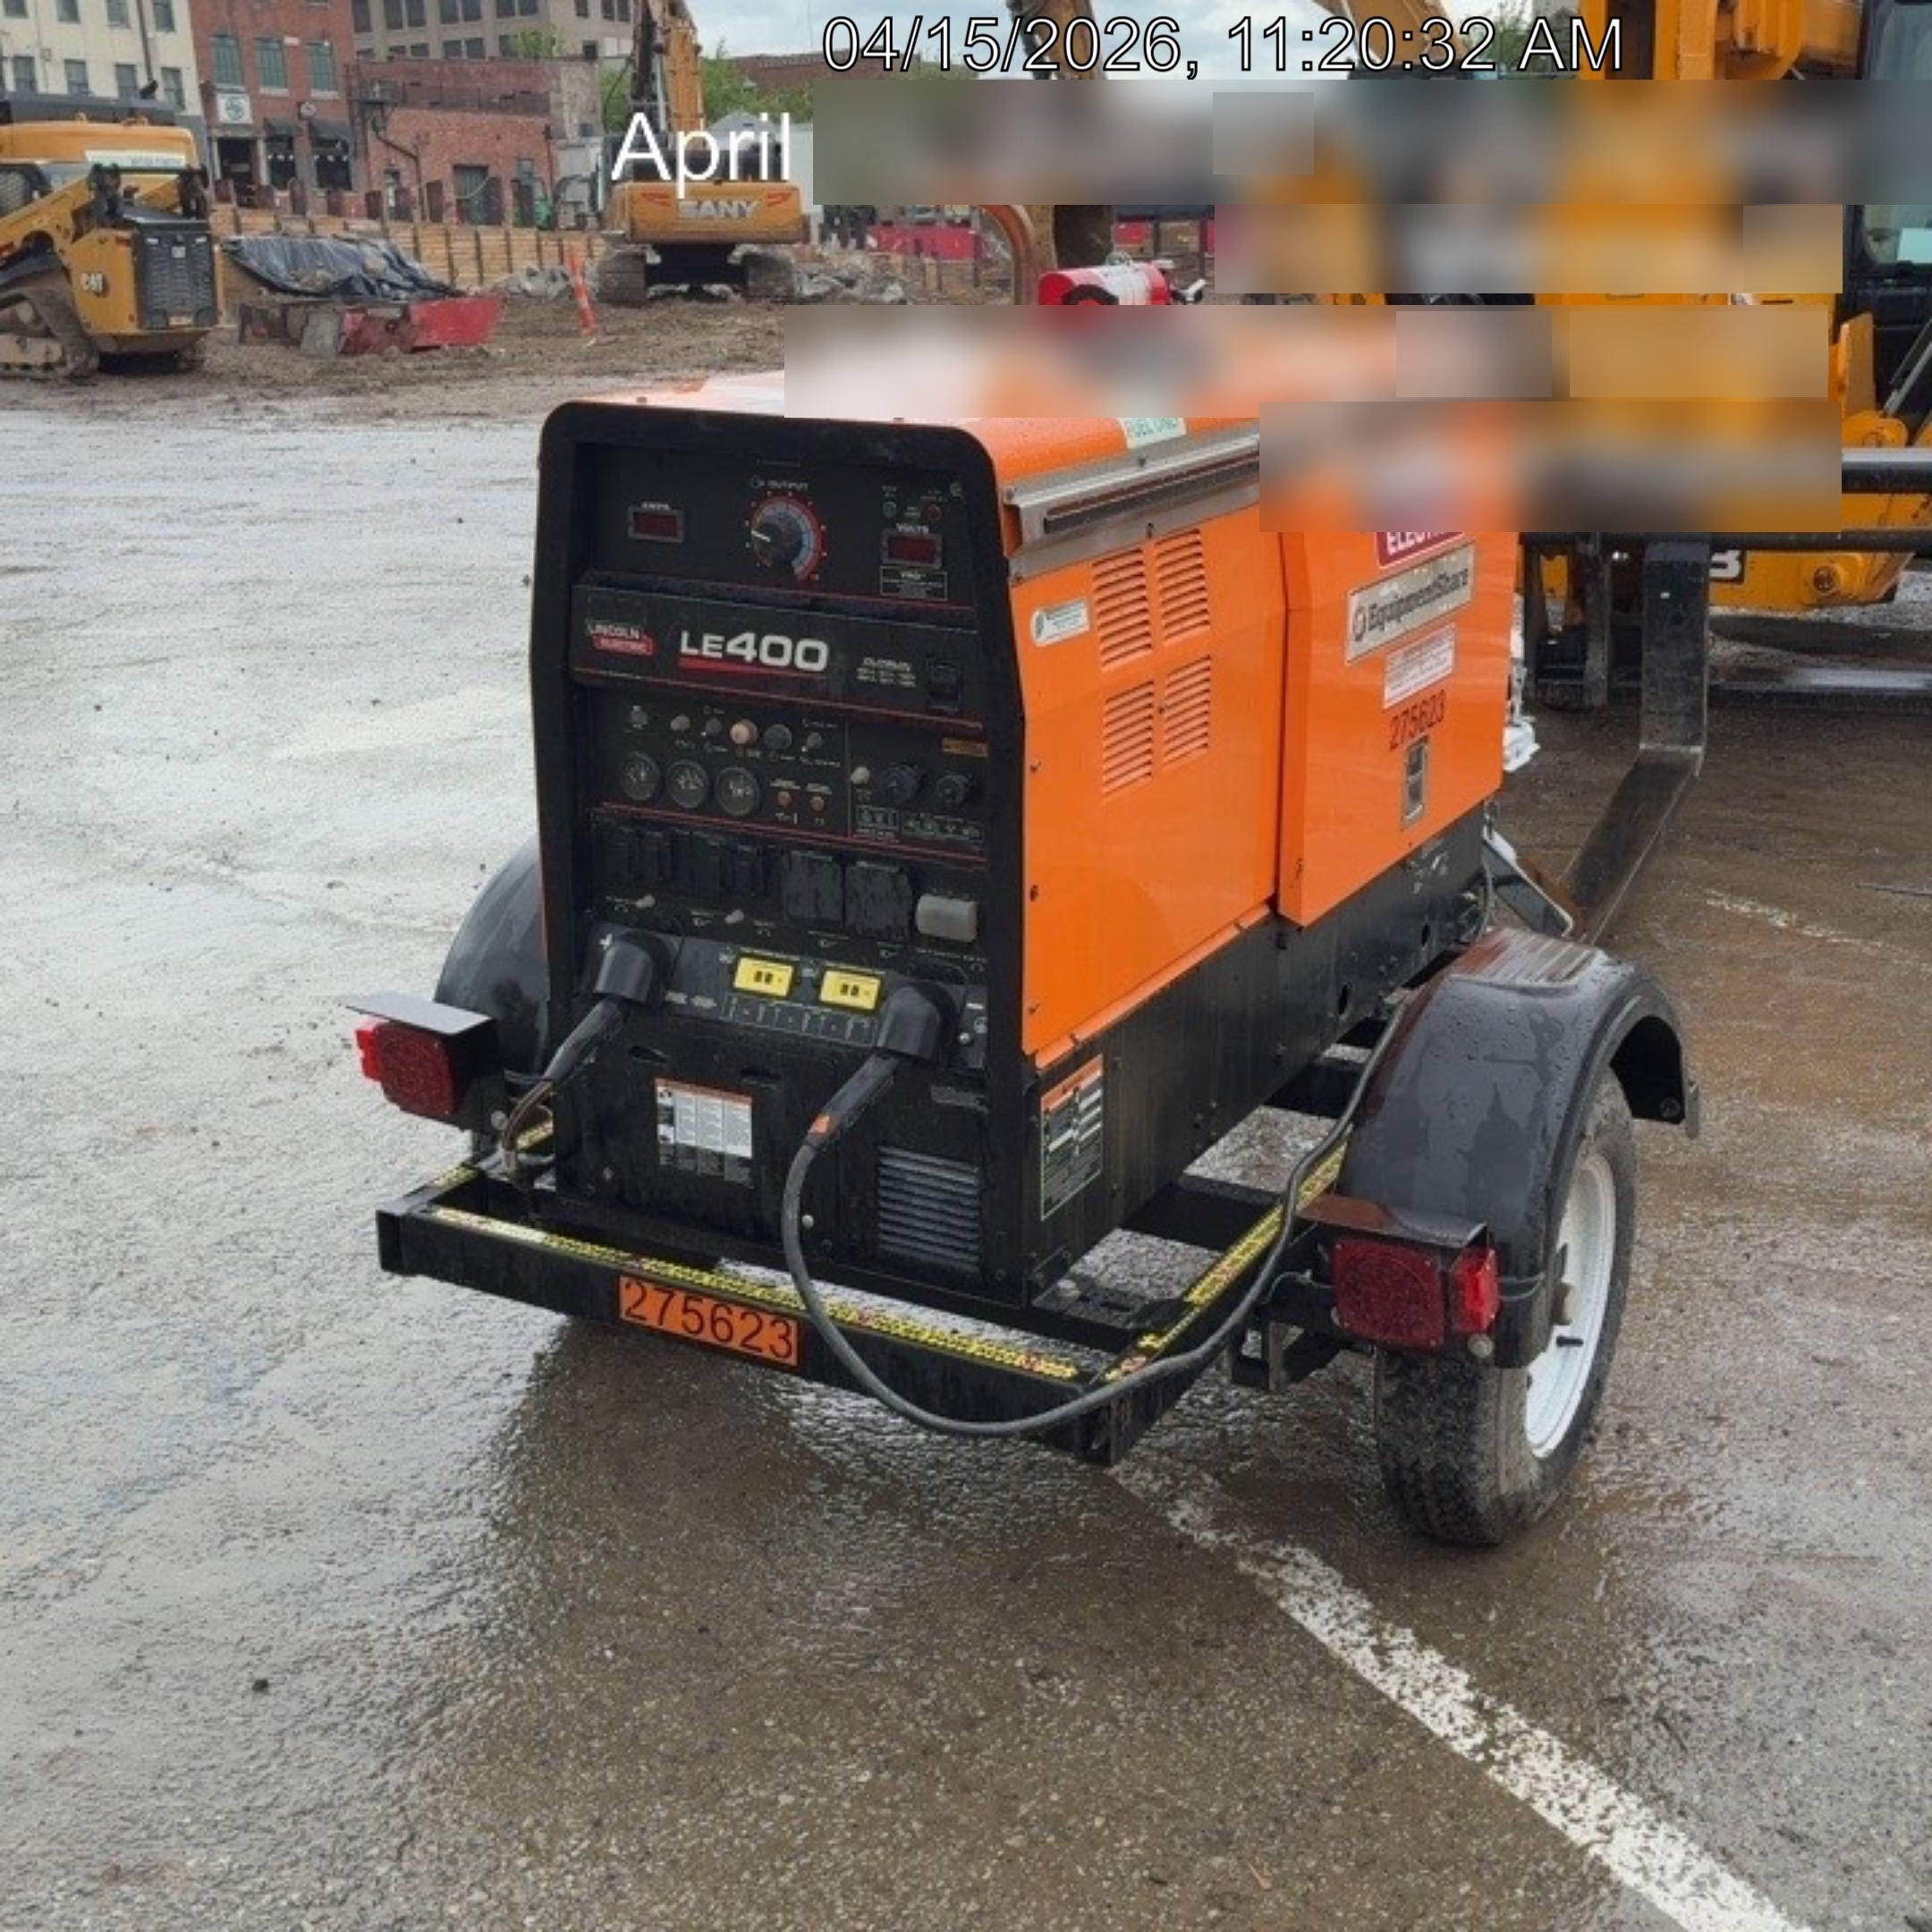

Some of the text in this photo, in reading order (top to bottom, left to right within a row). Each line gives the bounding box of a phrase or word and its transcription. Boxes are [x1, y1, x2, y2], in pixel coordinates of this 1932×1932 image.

[680, 631, 829, 672] LE400
[1389, 688, 1446, 751] 275623
[624, 1281, 793, 1359] 275623
